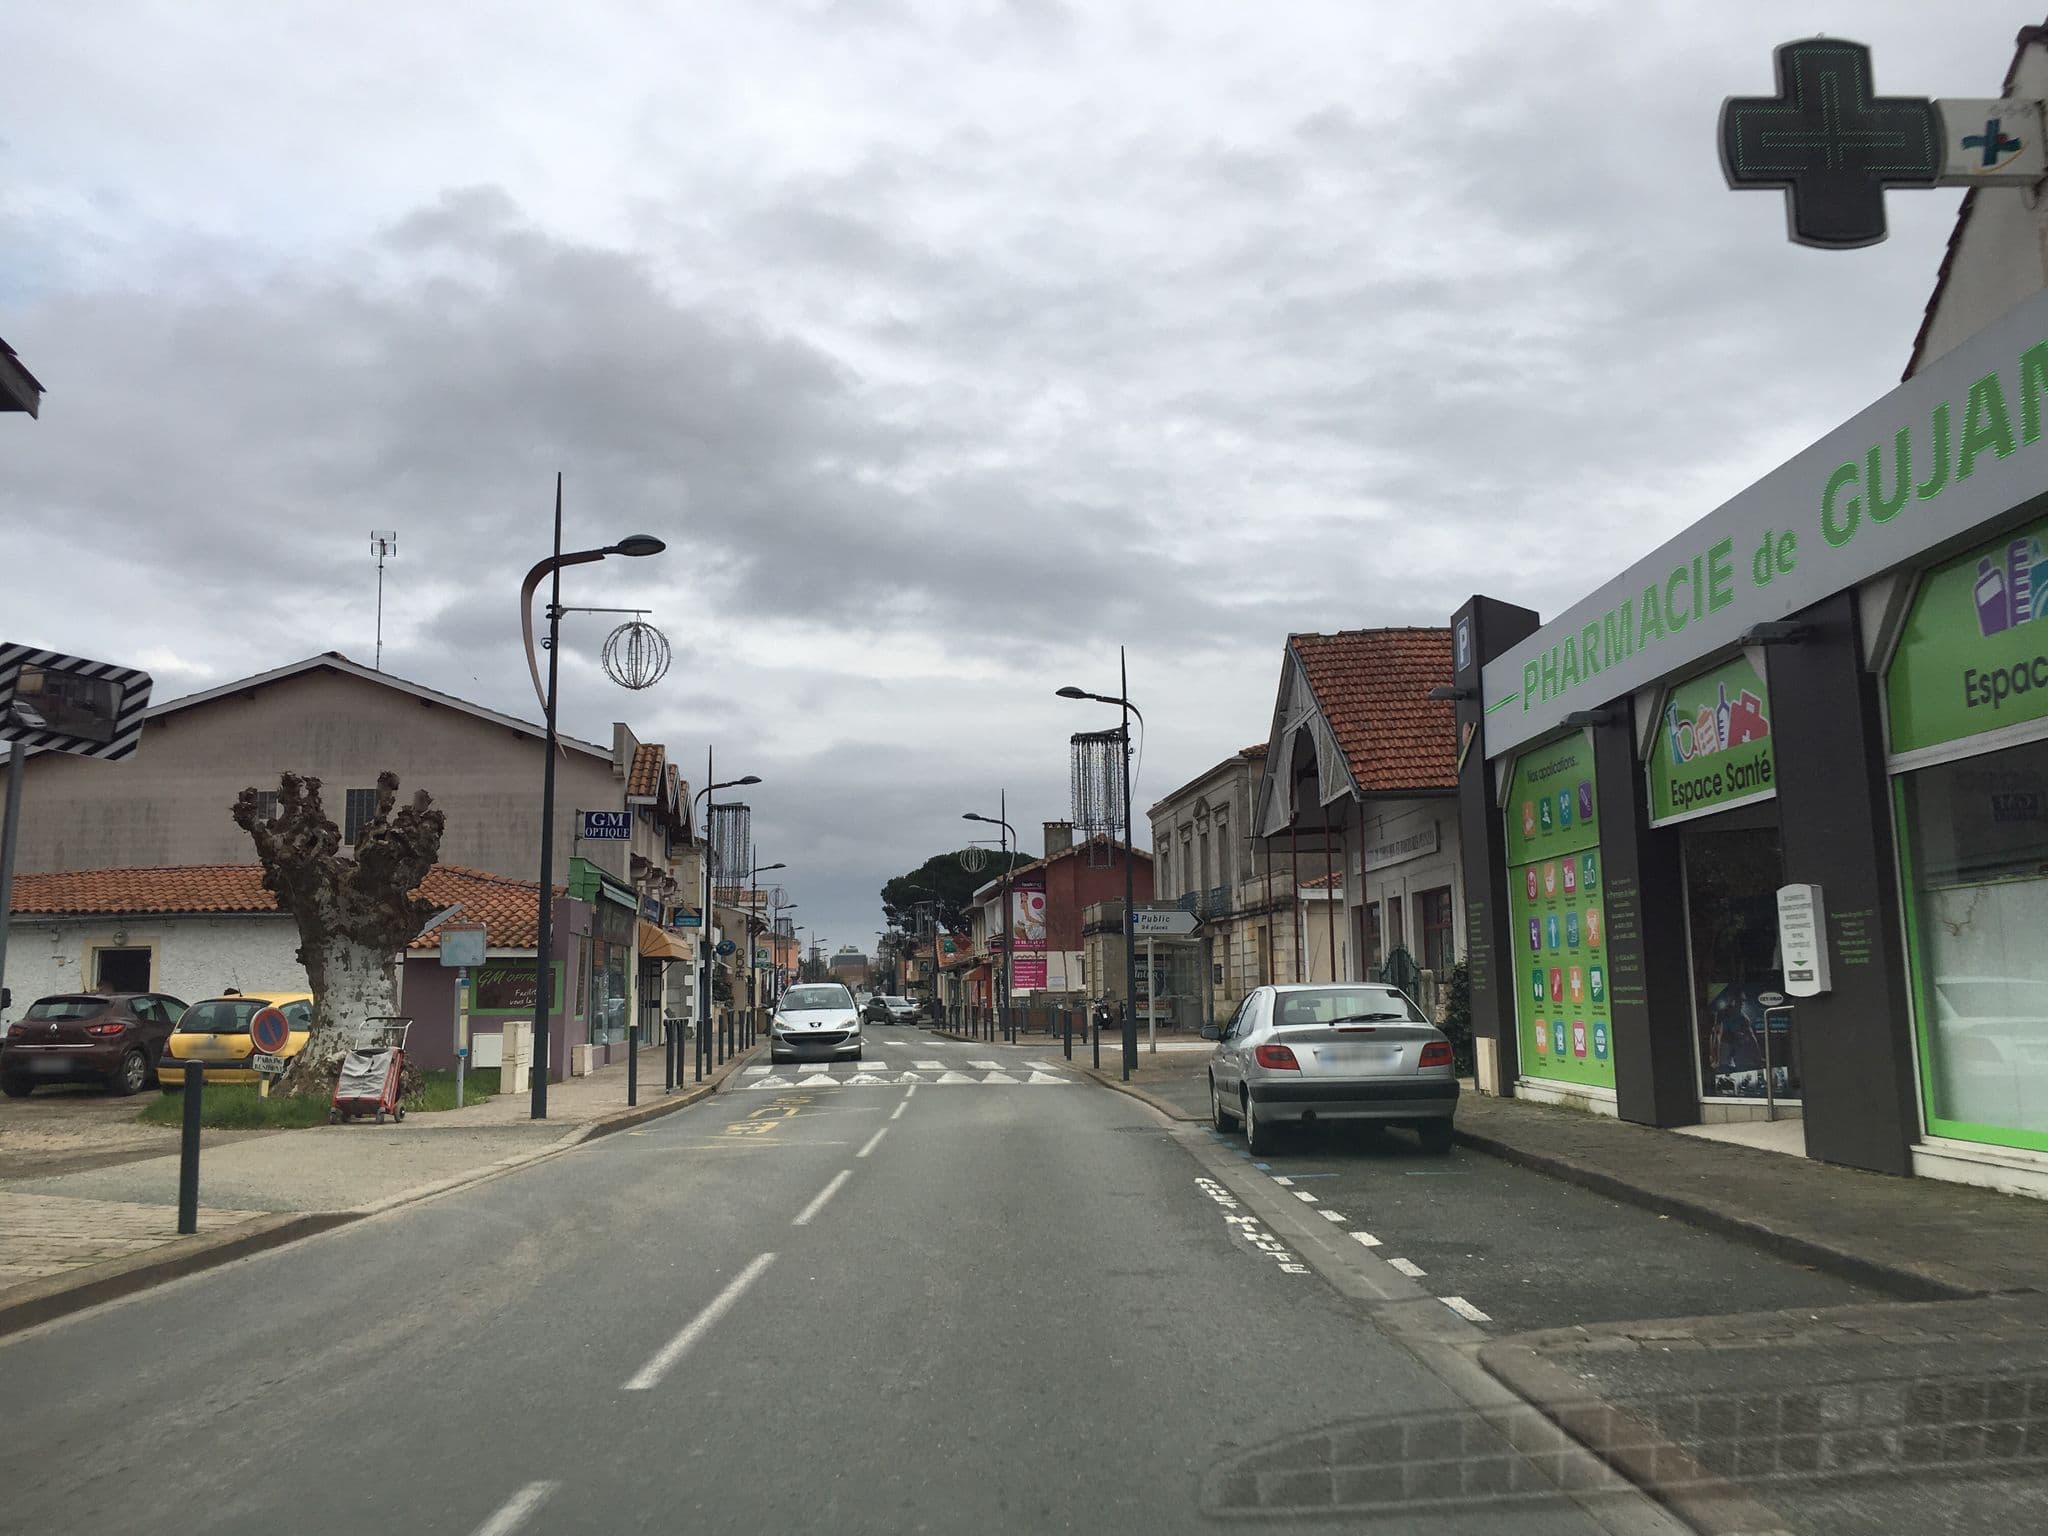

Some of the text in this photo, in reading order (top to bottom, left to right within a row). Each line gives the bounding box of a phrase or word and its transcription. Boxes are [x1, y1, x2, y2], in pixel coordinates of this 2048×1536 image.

[1523, 535, 1734, 713] PHARMACIE
[1752, 527, 1798, 588] de
[1671, 749, 1771, 808] Espace Santé
[591, 812, 625, 827] GM
[585, 827, 630, 839] OPTIQUE
[1141, 914, 1171, 924] Public
[736, 948, 745, 978] PHOTO
[479, 970, 507, 987] GM
[1224, 1216, 1312, 1274] MINUTE
